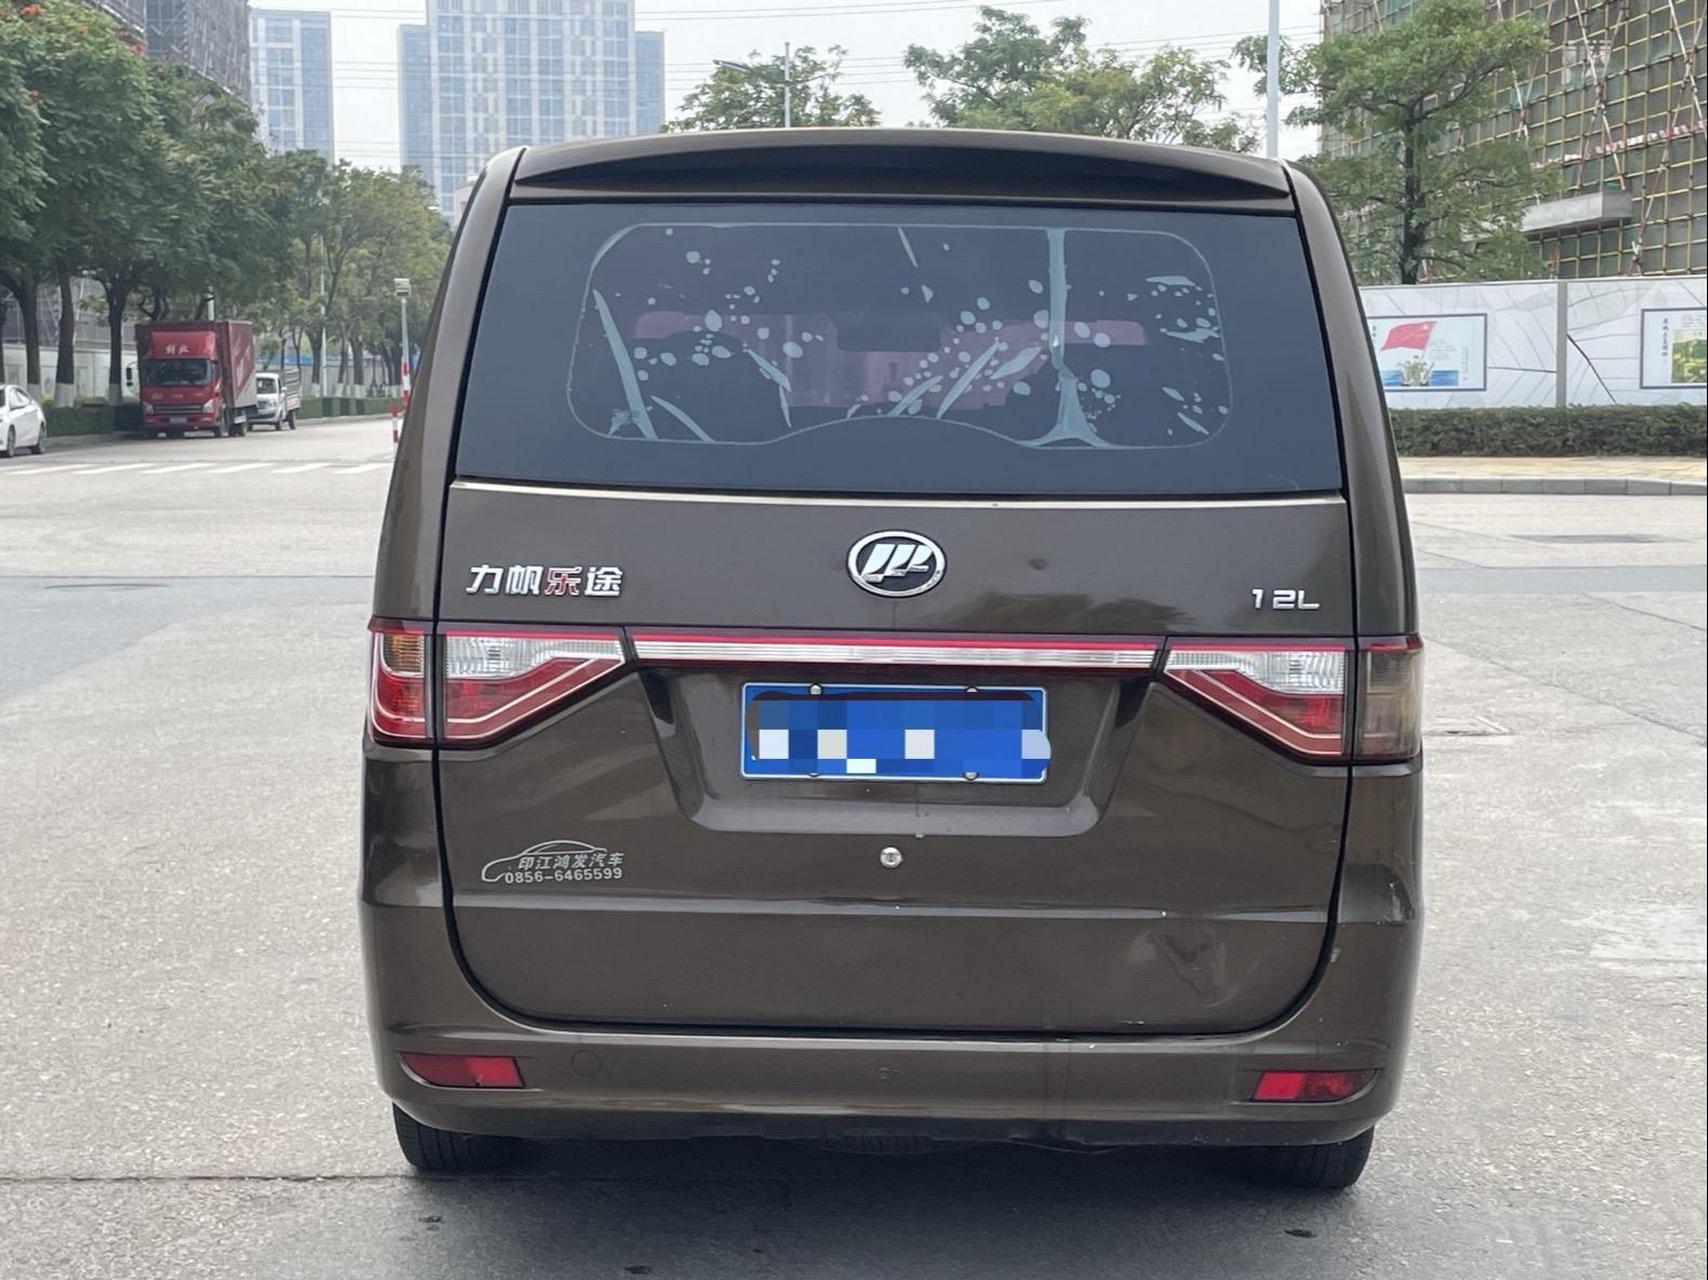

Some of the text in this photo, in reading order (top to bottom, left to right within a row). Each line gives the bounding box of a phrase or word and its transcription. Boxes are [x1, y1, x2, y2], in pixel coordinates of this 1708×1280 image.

[465, 564, 623, 597] 力帆乐途
[517, 852, 625, 871] 印江鸿发汽车
[505, 867, 623, 884] 0856-6465599
